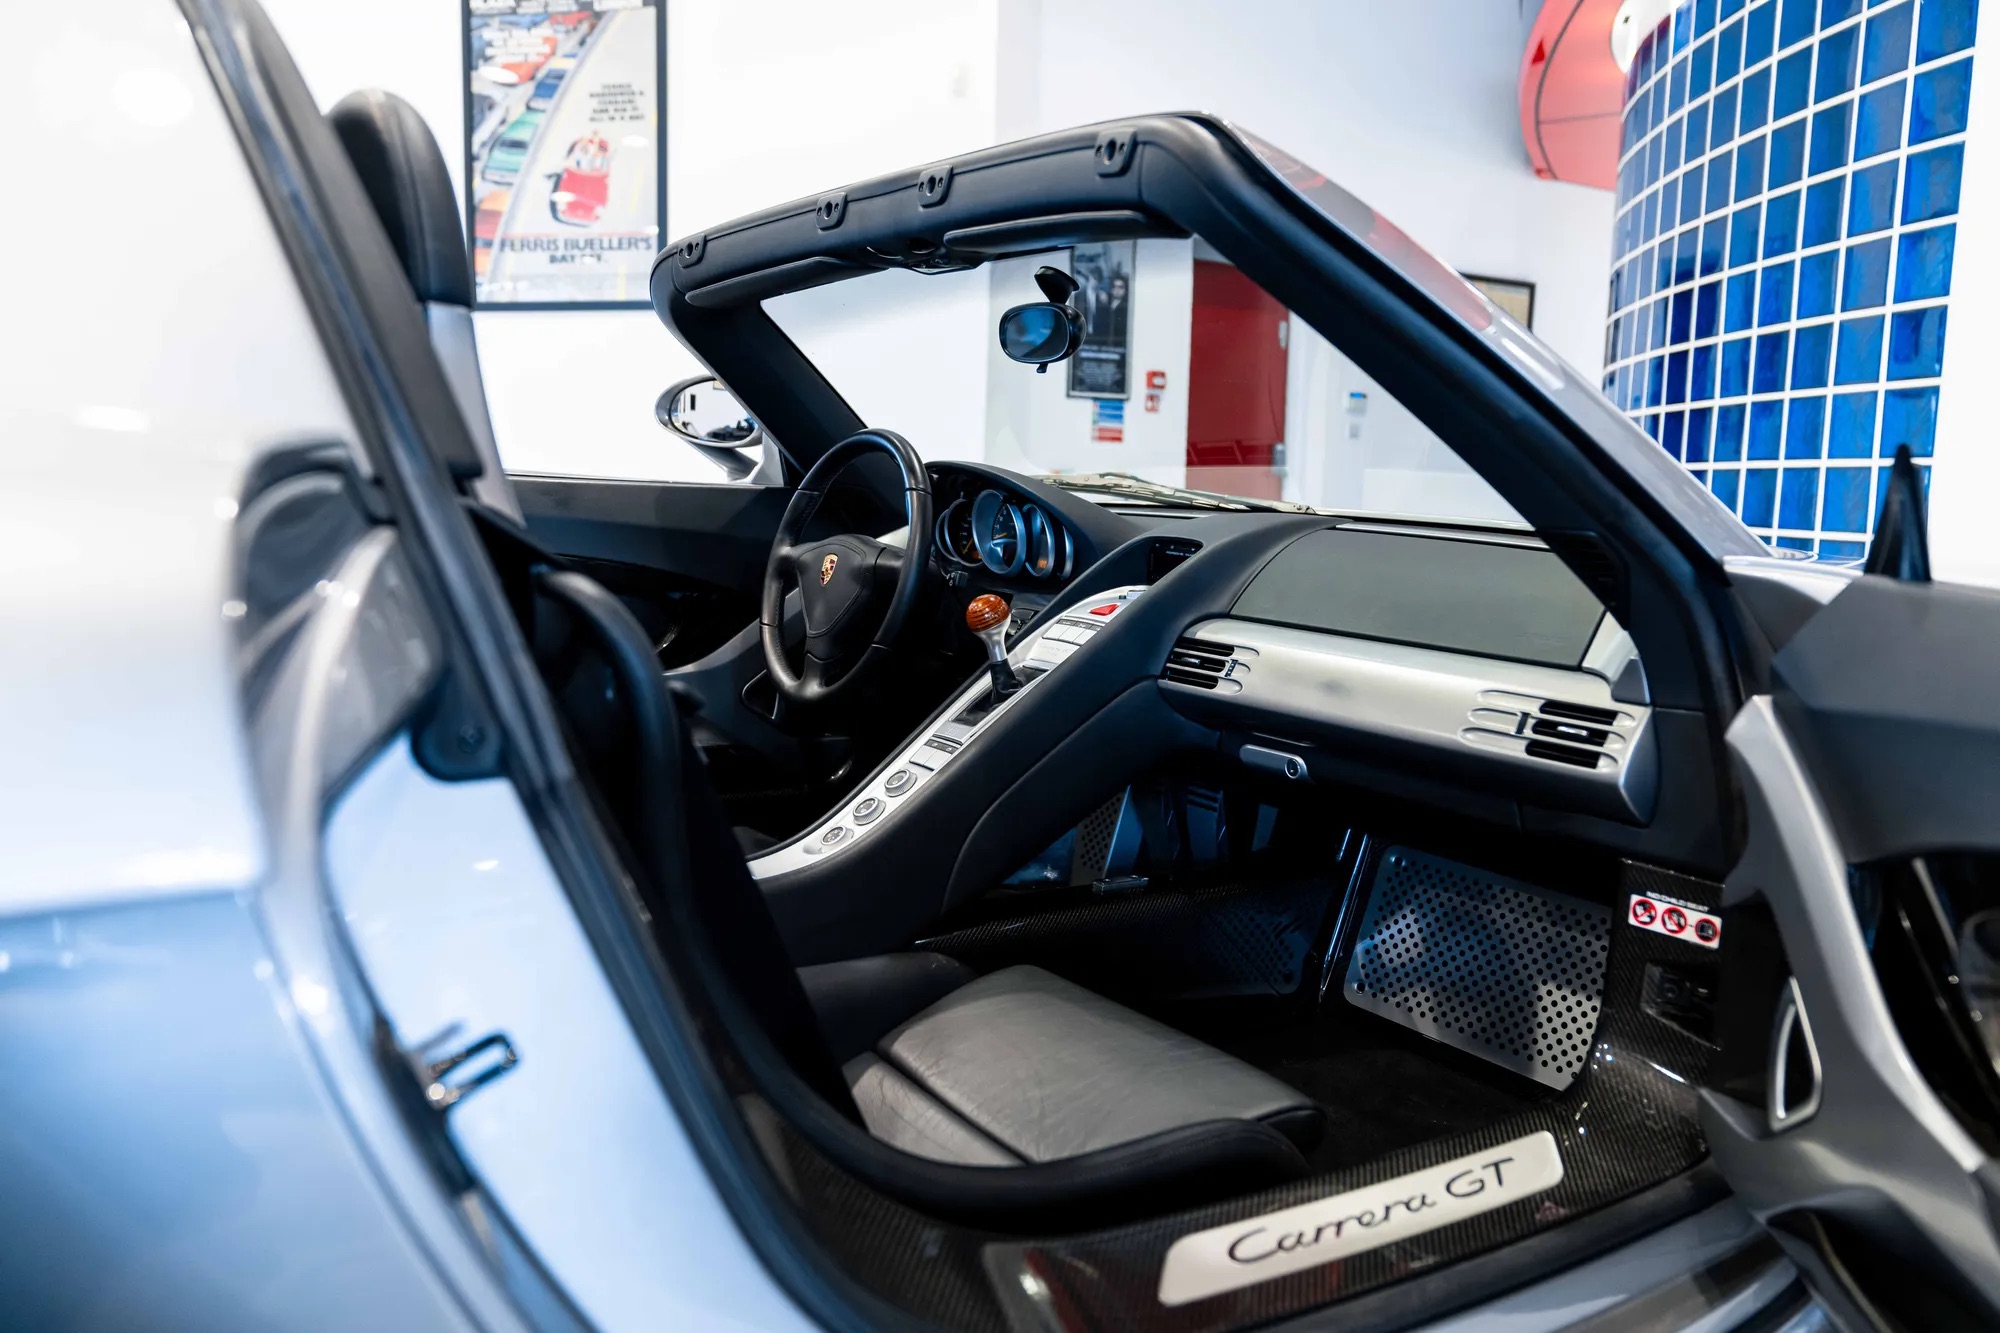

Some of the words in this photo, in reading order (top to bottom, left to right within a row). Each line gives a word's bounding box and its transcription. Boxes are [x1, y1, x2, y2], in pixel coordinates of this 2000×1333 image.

[500, 237, 559, 252] FERRIS
[1228, 1192, 1437, 1264] Carrera
[1445, 1157, 1515, 1198] GT
